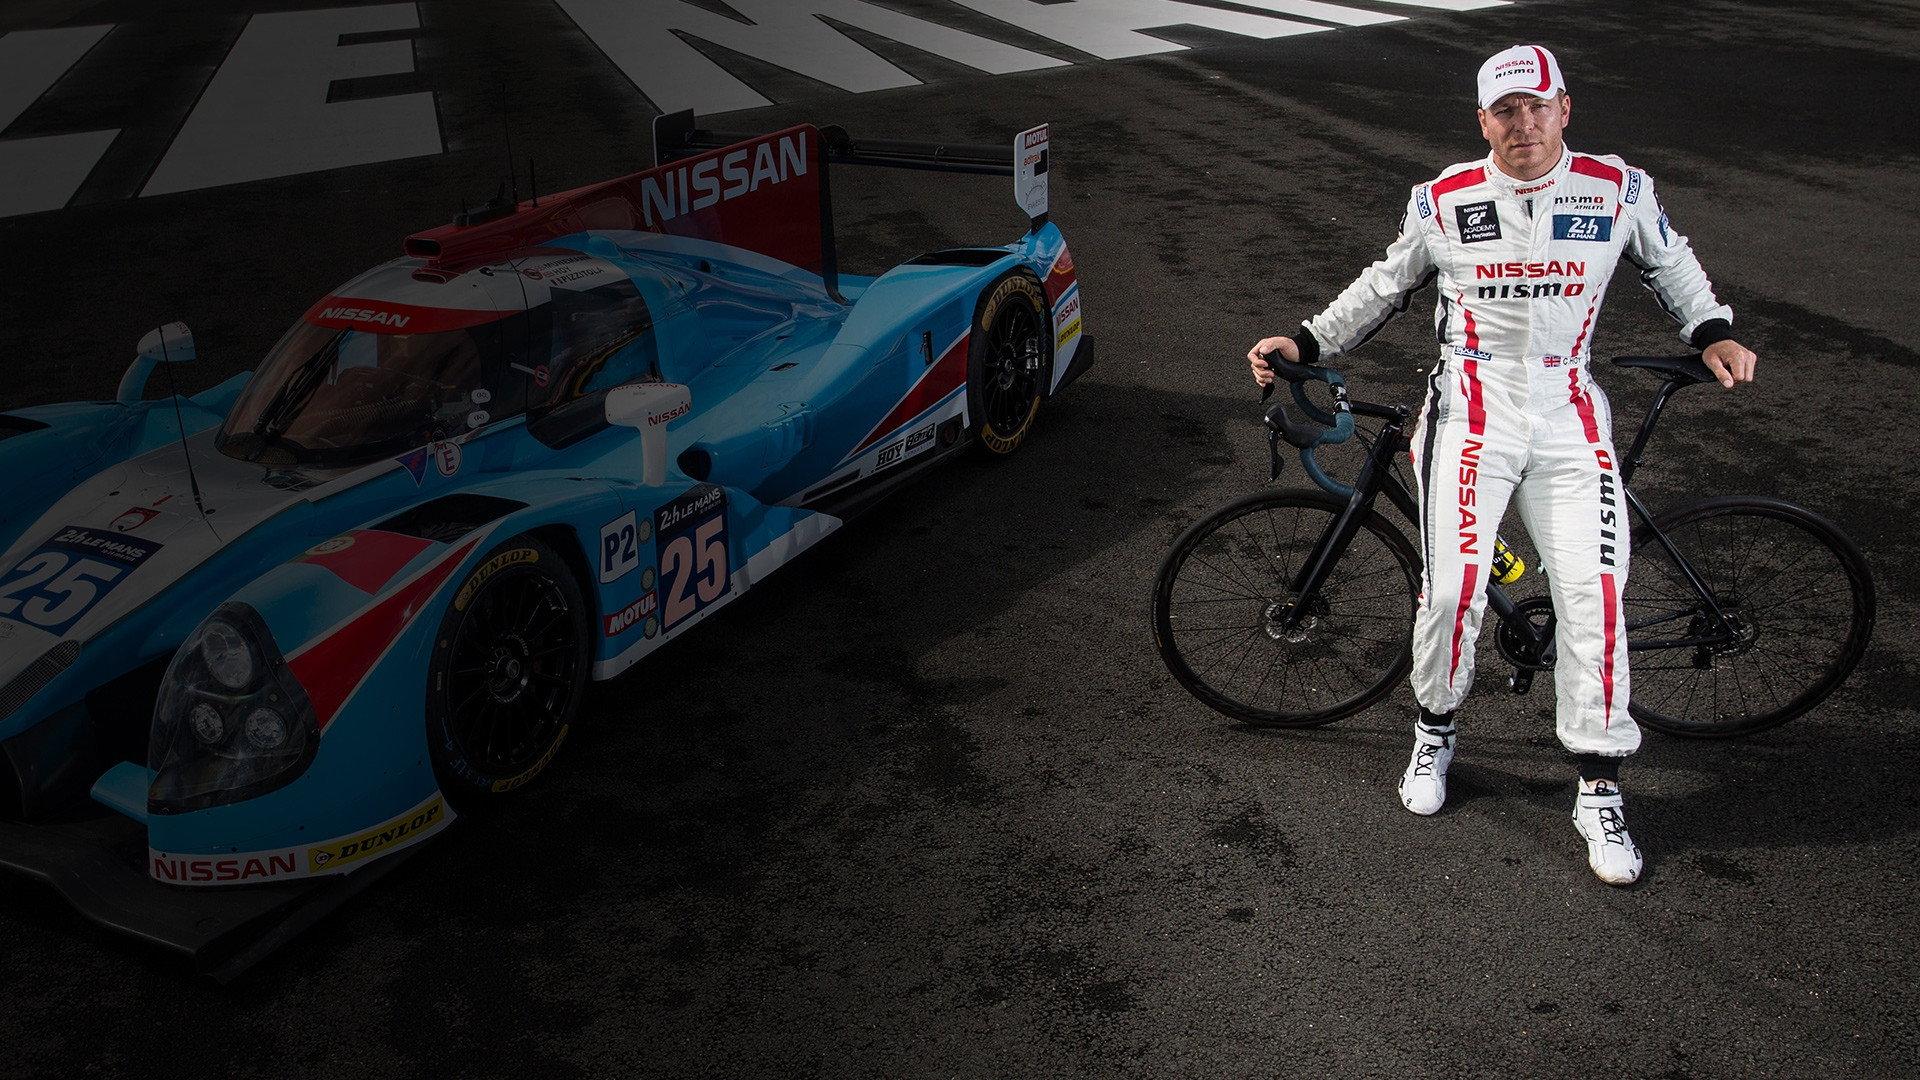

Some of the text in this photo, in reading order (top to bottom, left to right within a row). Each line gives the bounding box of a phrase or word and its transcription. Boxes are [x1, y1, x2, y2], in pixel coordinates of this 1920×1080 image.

[1495, 60, 1533, 71] NISSAN
[1495, 68, 1535, 79] nismo
[641, 131, 808, 227] NISSAN
[1515, 179, 1555, 195] NISSAN
[1463, 205, 1488, 213] NISSAN
[1555, 196, 1604, 204] nismo
[1463, 225, 1496, 234] ACADEMY
[1566, 231, 1596, 240] LE MANS
[1476, 261, 1585, 279] NISSAN
[1478, 283, 1585, 299] nismo
[319, 307, 411, 328] NISSAN
[647, 402, 690, 427] NISSAN
[681, 503, 695, 519] LE
[694, 488, 721, 511] MANS
[1458, 439, 1483, 555] NISSAN
[1595, 449, 1617, 566] nismo
[605, 525, 636, 573] P2
[661, 515, 727, 628] 25
[0, 551, 124, 626] 25
[608, 593, 657, 634] MOTUL
[337, 804, 439, 859] DUNLOP
[155, 853, 296, 881] NISSAN
